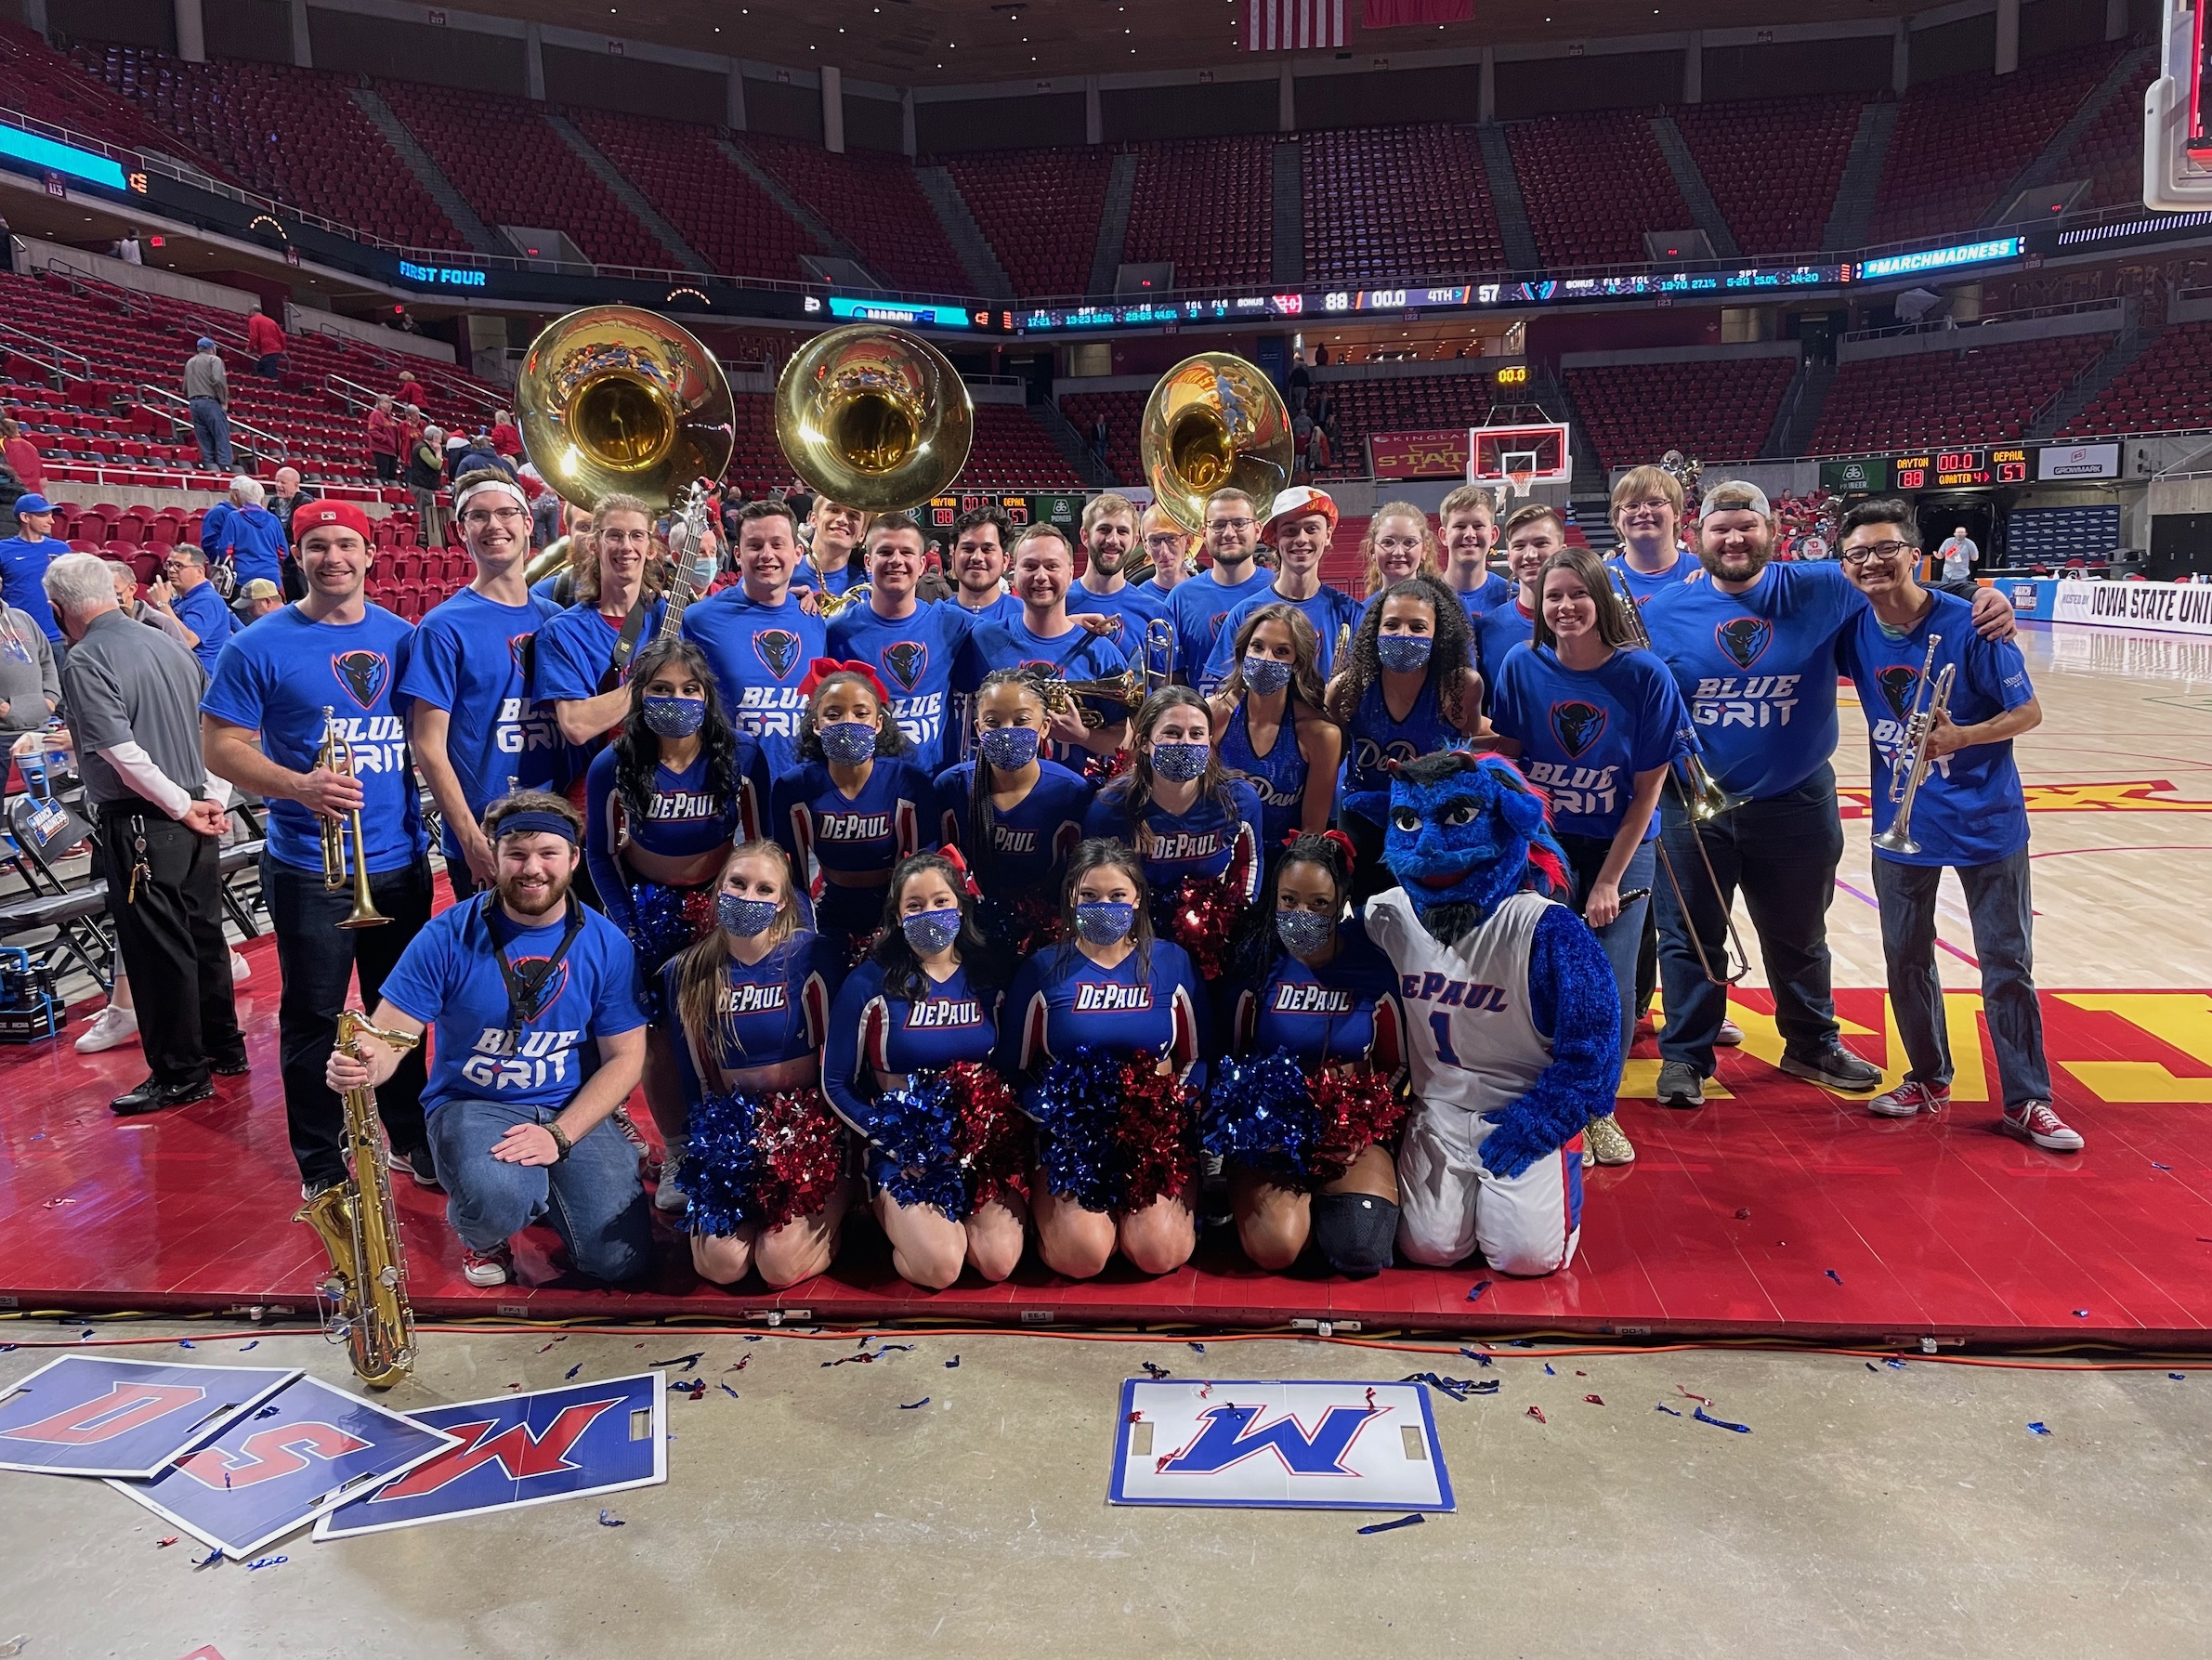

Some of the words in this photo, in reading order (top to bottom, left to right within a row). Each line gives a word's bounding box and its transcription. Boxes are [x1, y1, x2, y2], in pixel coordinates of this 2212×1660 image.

[48, 182, 63, 196] 113
[1868, 242, 2010, 273] #MARCHMADNESS
[399, 260, 438, 282] FIRST
[440, 269, 486, 286] FOUR
[1790, 273, 1819, 283] 14-20
[1797, 267, 1811, 275] FT
[1565, 280, 1594, 289] BONUS
[1603, 278, 1621, 286] FLS
[1630, 276, 1649, 284] TOL
[1661, 281, 1688, 291] 19-70
[1726, 277, 1750, 287] 5-20
[1427, 289, 1453, 302] 4TH
[1479, 284, 1500, 302] 57
[1608, 285, 1616, 294] 4
[1185, 301, 1203, 309] TOL
[1211, 298, 1229, 307] FLS
[1237, 297, 1264, 307] BONUS
[1325, 292, 1348, 310] 88
[1371, 290, 1407, 307] 00.0
[1657, 299, 1672, 307] 123
[1066, 314, 1091, 324] 13-23
[1190, 309, 1198, 318] 3
[1216, 307, 1224, 317] 3
[1404, 313, 1419, 321] 122
[1027, 317, 1051, 327] 17-21
[1498, 369, 1526, 383] 00.0
[1378, 451, 1493, 466] STATE
[1897, 457, 1930, 469] DAYTON
[1939, 453, 1972, 471] 00.0
[1994, 451, 2026, 463] DEPAUL
[2004, 465, 2024, 480] 57
[2055, 465, 2101, 474] GROWMARK
[1904, 472, 1923, 487] 88
[1939, 473, 1972, 485] QUARTER
[1973, 472, 1982, 484] 4
[931, 497, 956, 507] DAYTON
[963, 496, 989, 512] 000
[1003, 498, 1026, 507] DEPAUL
[936, 511, 952, 524] 88
[1013, 510, 1027, 523] 57
[2061, 594, 2082, 604] HOSTED
[2082, 595, 2090, 605] BY
[2092, 586, 2127, 618] IOWA
[2130, 588, 2177, 621] STATE
[2179, 590, 2212, 624] UNI
[1693, 674, 1801, 699] BLUE
[497, 698, 554, 722] BL
[887, 691, 942, 718] LUE
[1693, 699, 1799, 728] GRIT
[317, 715, 404, 743] BLUE
[736, 712, 805, 737] GRI
[897, 713, 940, 744] RIT
[497, 723, 566, 752] GRI
[1356, 738, 1417, 772] DeP
[1526, 762, 1620, 790] BLUE
[1251, 777, 1304, 807] Paul
[1543, 788, 1616, 815] RIT
[994, 826, 1037, 853] PAUL
[1401, 972, 1508, 1013] EPAUL
[472, 1027, 581, 1056] BLUE
[1429, 1011, 1462, 1068] 1
[462, 1049, 569, 1090] GRIT
[0, 1381, 206, 1445] D
[171, 1421, 375, 1490] S
